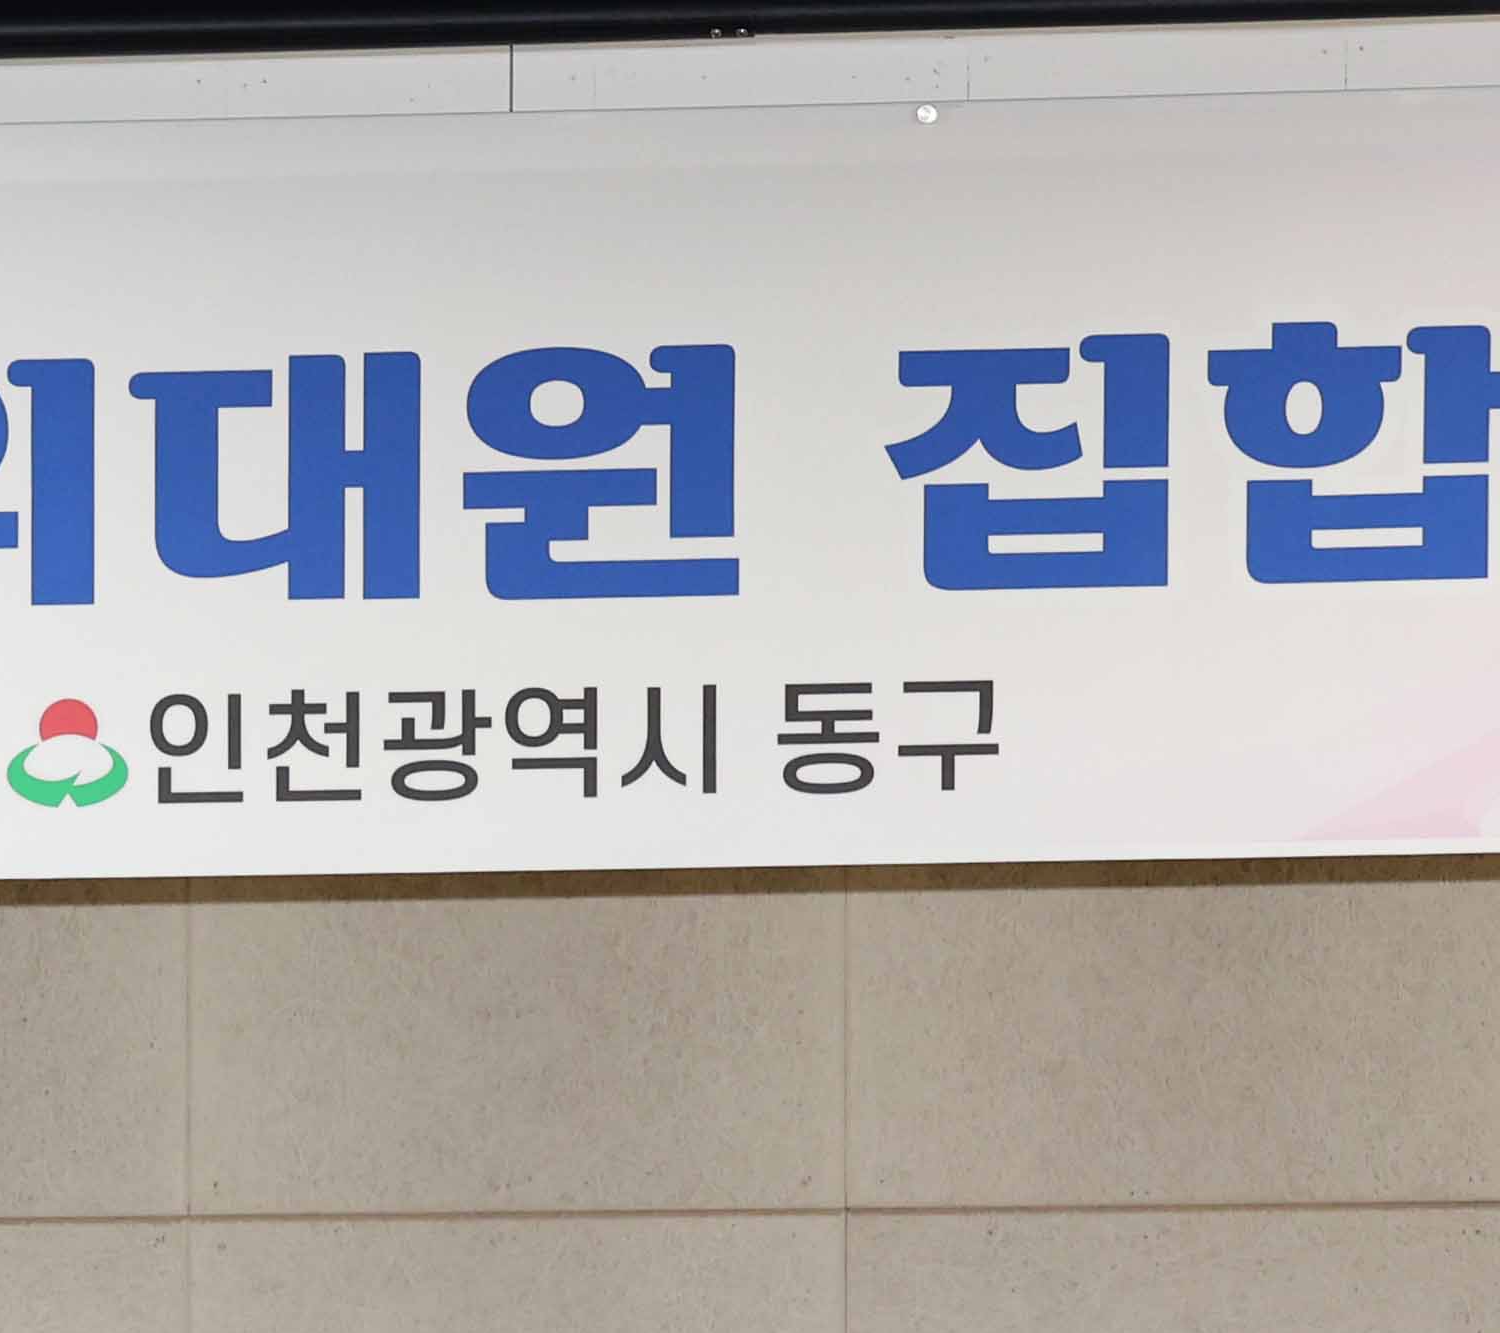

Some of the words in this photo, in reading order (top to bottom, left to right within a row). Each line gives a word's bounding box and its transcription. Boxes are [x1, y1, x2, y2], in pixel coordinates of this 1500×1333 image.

[886, 321, 1500, 591] 집합
[148, 683, 718, 805] 인천광역시
[776, 678, 1000, 796] 동구
